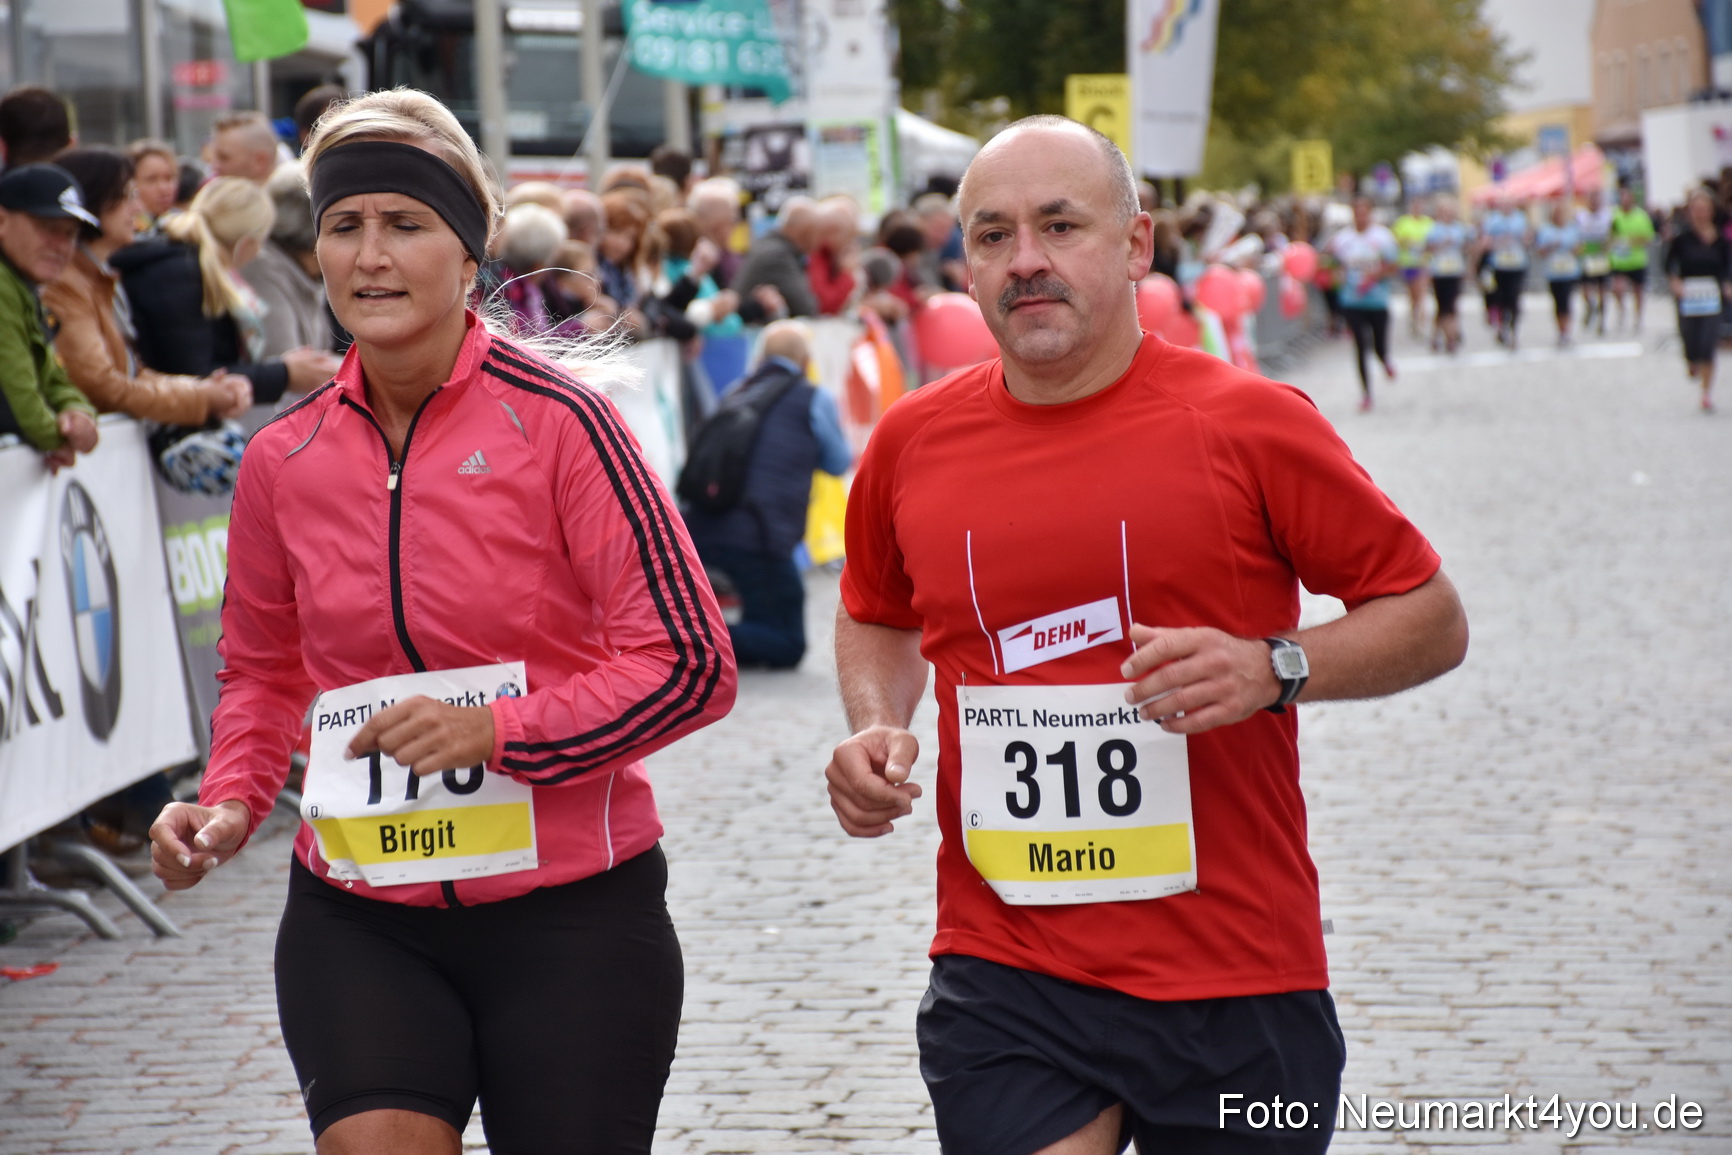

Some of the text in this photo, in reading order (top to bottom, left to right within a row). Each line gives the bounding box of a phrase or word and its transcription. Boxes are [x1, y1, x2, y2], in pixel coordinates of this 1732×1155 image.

[457, 465, 491, 475] adidas
[1033, 618, 1086, 651] DEHN
[964, 707, 1141, 728] PARTL Neumarkt
[1004, 739, 1142, 819] 318
[970, 813, 978, 827] C
[379, 820, 456, 857] Birgit
[1028, 841, 1116, 873] Mario
